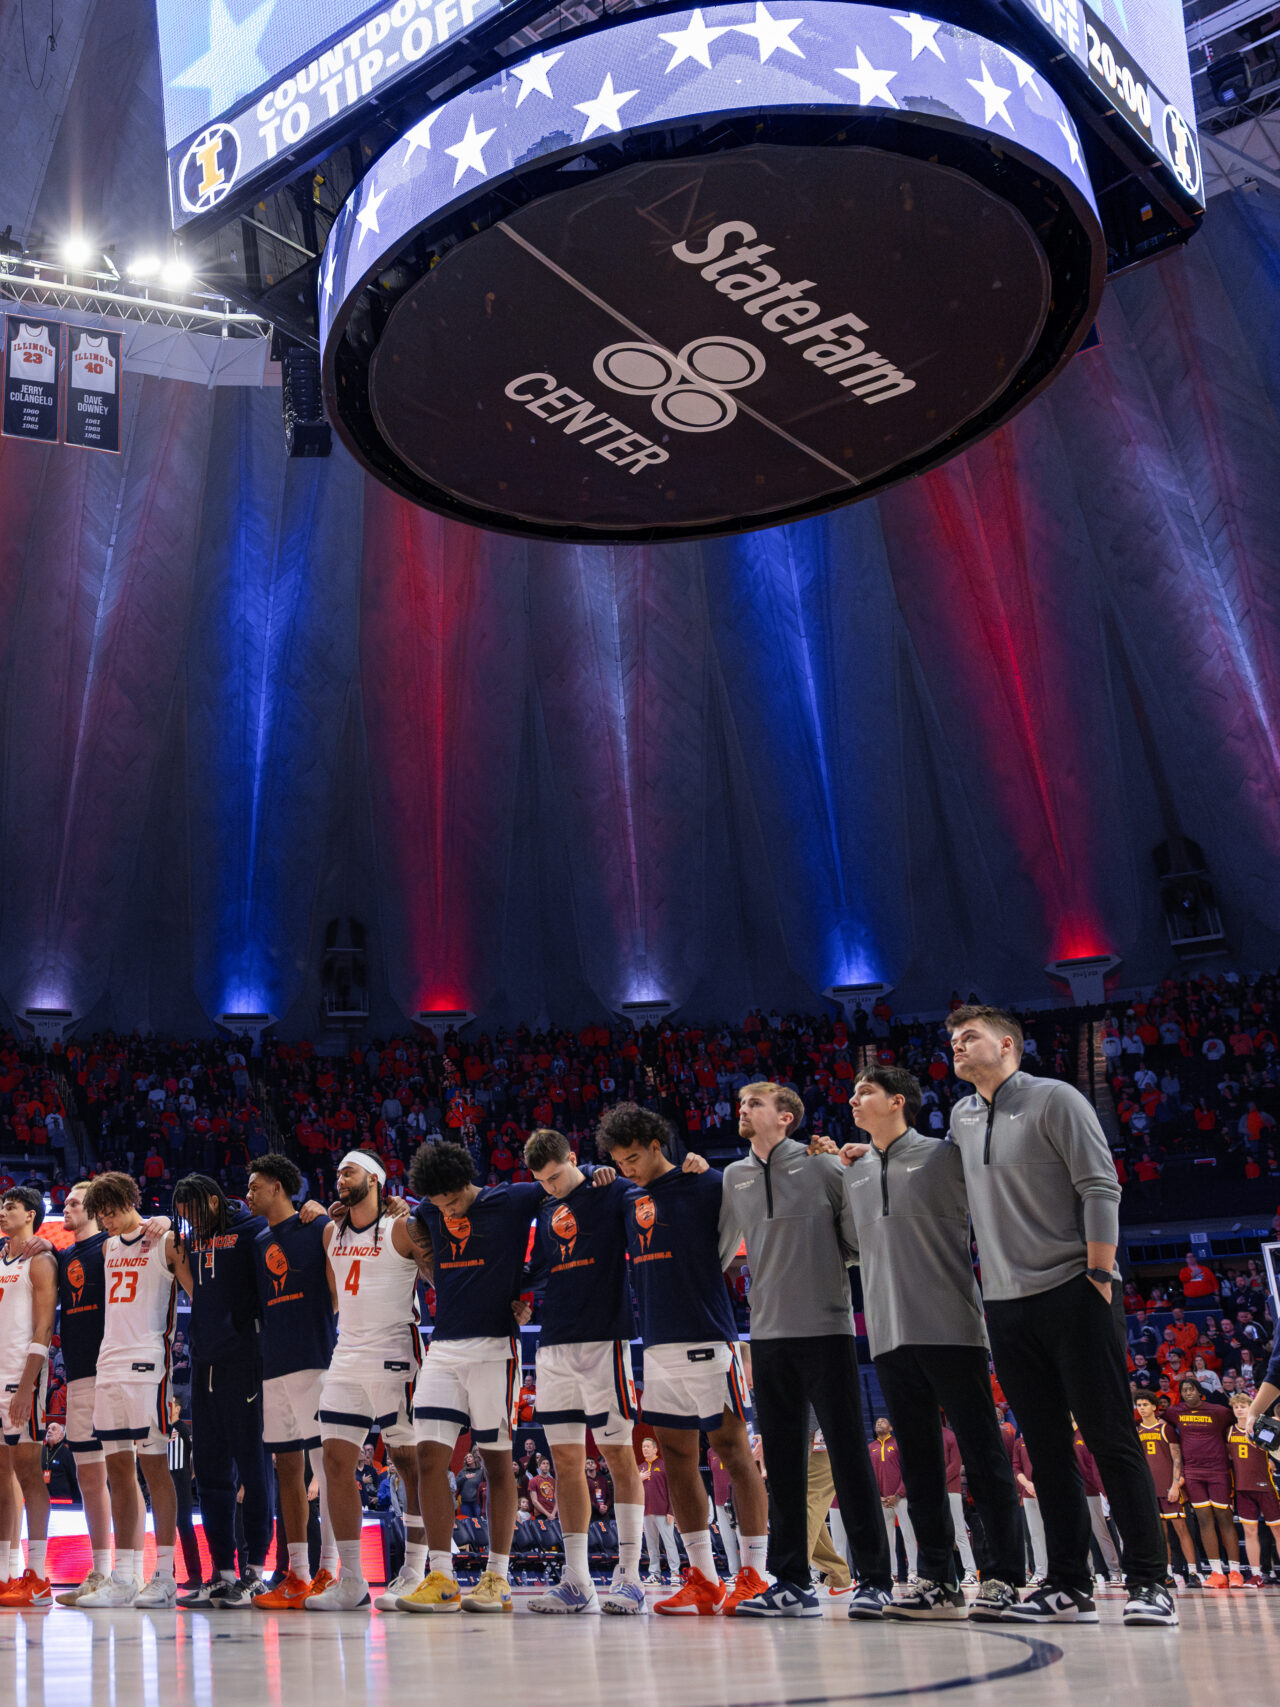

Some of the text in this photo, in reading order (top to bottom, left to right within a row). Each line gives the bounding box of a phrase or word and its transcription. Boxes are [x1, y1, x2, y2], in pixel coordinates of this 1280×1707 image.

[257, 0, 433, 122] COUNTDO
[1086, 23, 1152, 128] 20:00
[258, 101, 310, 160] TO
[13, 342, 53, 357] ILLINOIS
[23, 351, 43, 364] 23
[75, 352, 113, 367] ILLINOIS
[84, 362, 104, 375] 40
[21, 384, 43, 395] JERRY
[10, 392, 53, 406] COLANGELO
[84, 394, 103, 406] DAVE
[77, 403, 109, 416] DOWNEY
[504, 371, 670, 475] CENTER
[331, 1246, 382, 1257] ILLINOIS
[107, 1257, 149, 1268] ILLINOIS
[345, 1260, 361, 1296] 4
[108, 1271, 139, 1304] 23
[1147, 1441, 1156, 1455] 9
[1238, 1444, 1248, 1458] 8
